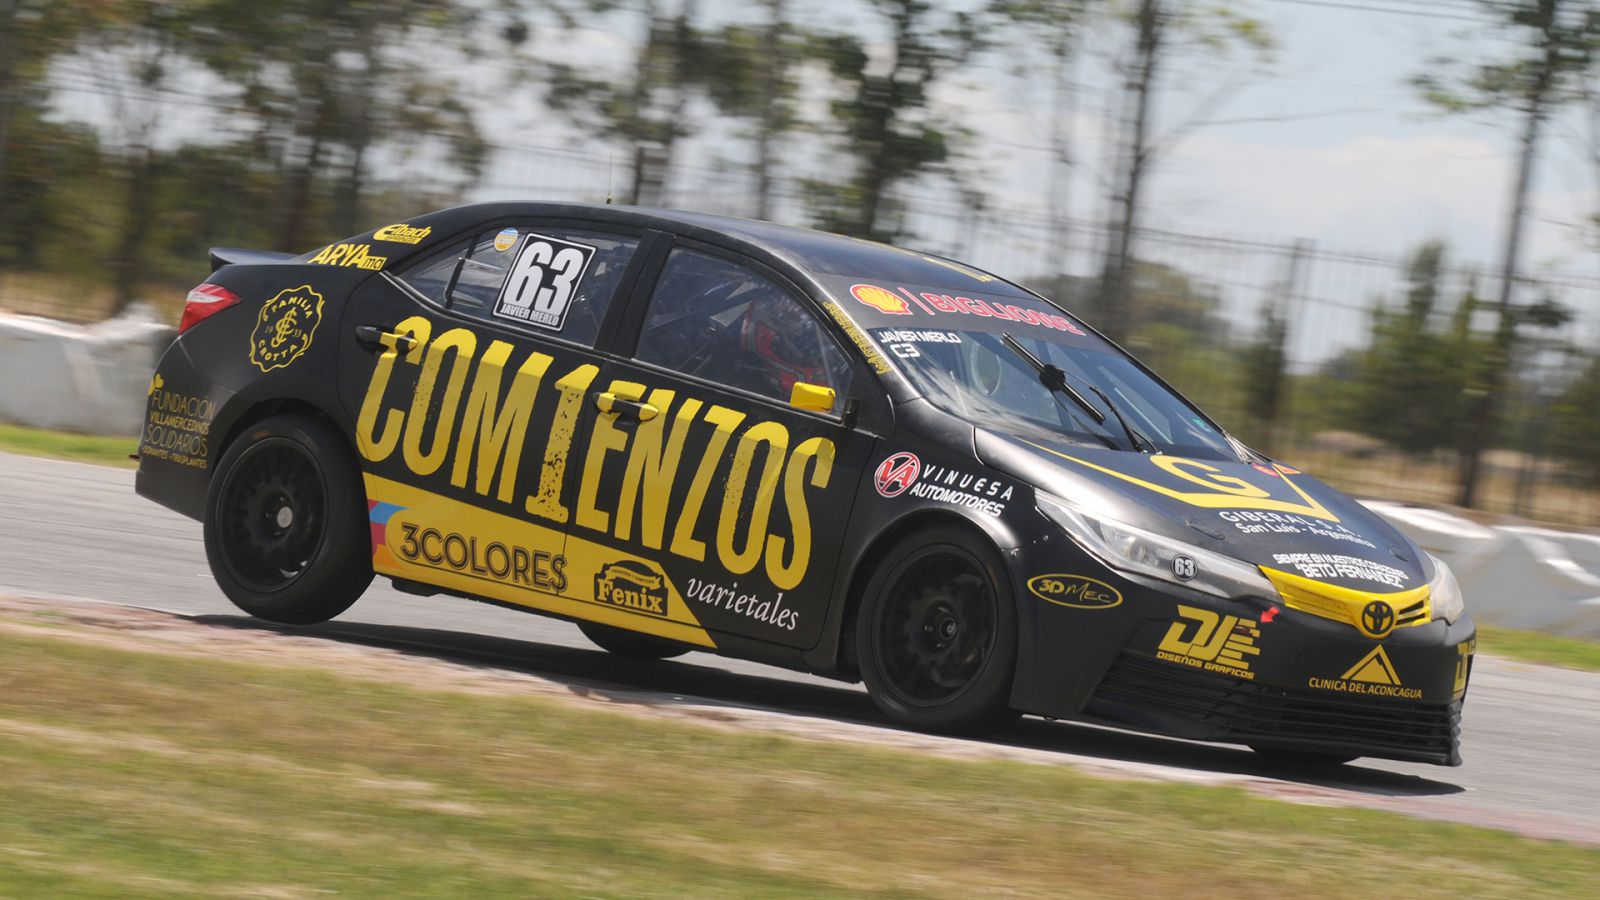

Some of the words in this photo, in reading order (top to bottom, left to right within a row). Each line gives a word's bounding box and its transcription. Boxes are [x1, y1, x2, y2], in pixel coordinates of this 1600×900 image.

[307, 243, 370, 267] ARYA
[503, 241, 584, 316] 63
[271, 296, 313, 319] FAMILIA
[500, 303, 530, 320] JAVIER
[529, 309, 560, 327] MERLO
[920, 292, 1087, 336] BIGLIONE
[878, 330, 921, 343] JAVIER
[915, 330, 962, 344] MERLO
[258, 339, 298, 361] CROTTA
[890, 343, 920, 358] C3
[152, 389, 217, 420] FUNDACIÓN
[144, 424, 208, 457] SOLIDARIOS
[355, 315, 836, 589] COM1ENZOS
[923, 464, 1014, 501] VINUESA
[909, 482, 1005, 517] AUTOMOTORES
[1218, 511, 1316, 527] GIBERAL
[1235, 523, 1269, 534] San
[1266, 522, 1301, 534] Luis
[400, 522, 568, 593] 3COLORES
[1175, 557, 1194, 577] 63
[1272, 553, 1312, 564] SIEMPRE
[597, 578, 663, 614] Fenix
[1039, 579, 1065, 594] 3D
[687, 577, 799, 631] varietales
[1308, 677, 1347, 691] CLINICA
[1348, 682, 1366, 694] DEL
[1367, 684, 1422, 699] ACONCAGUA
